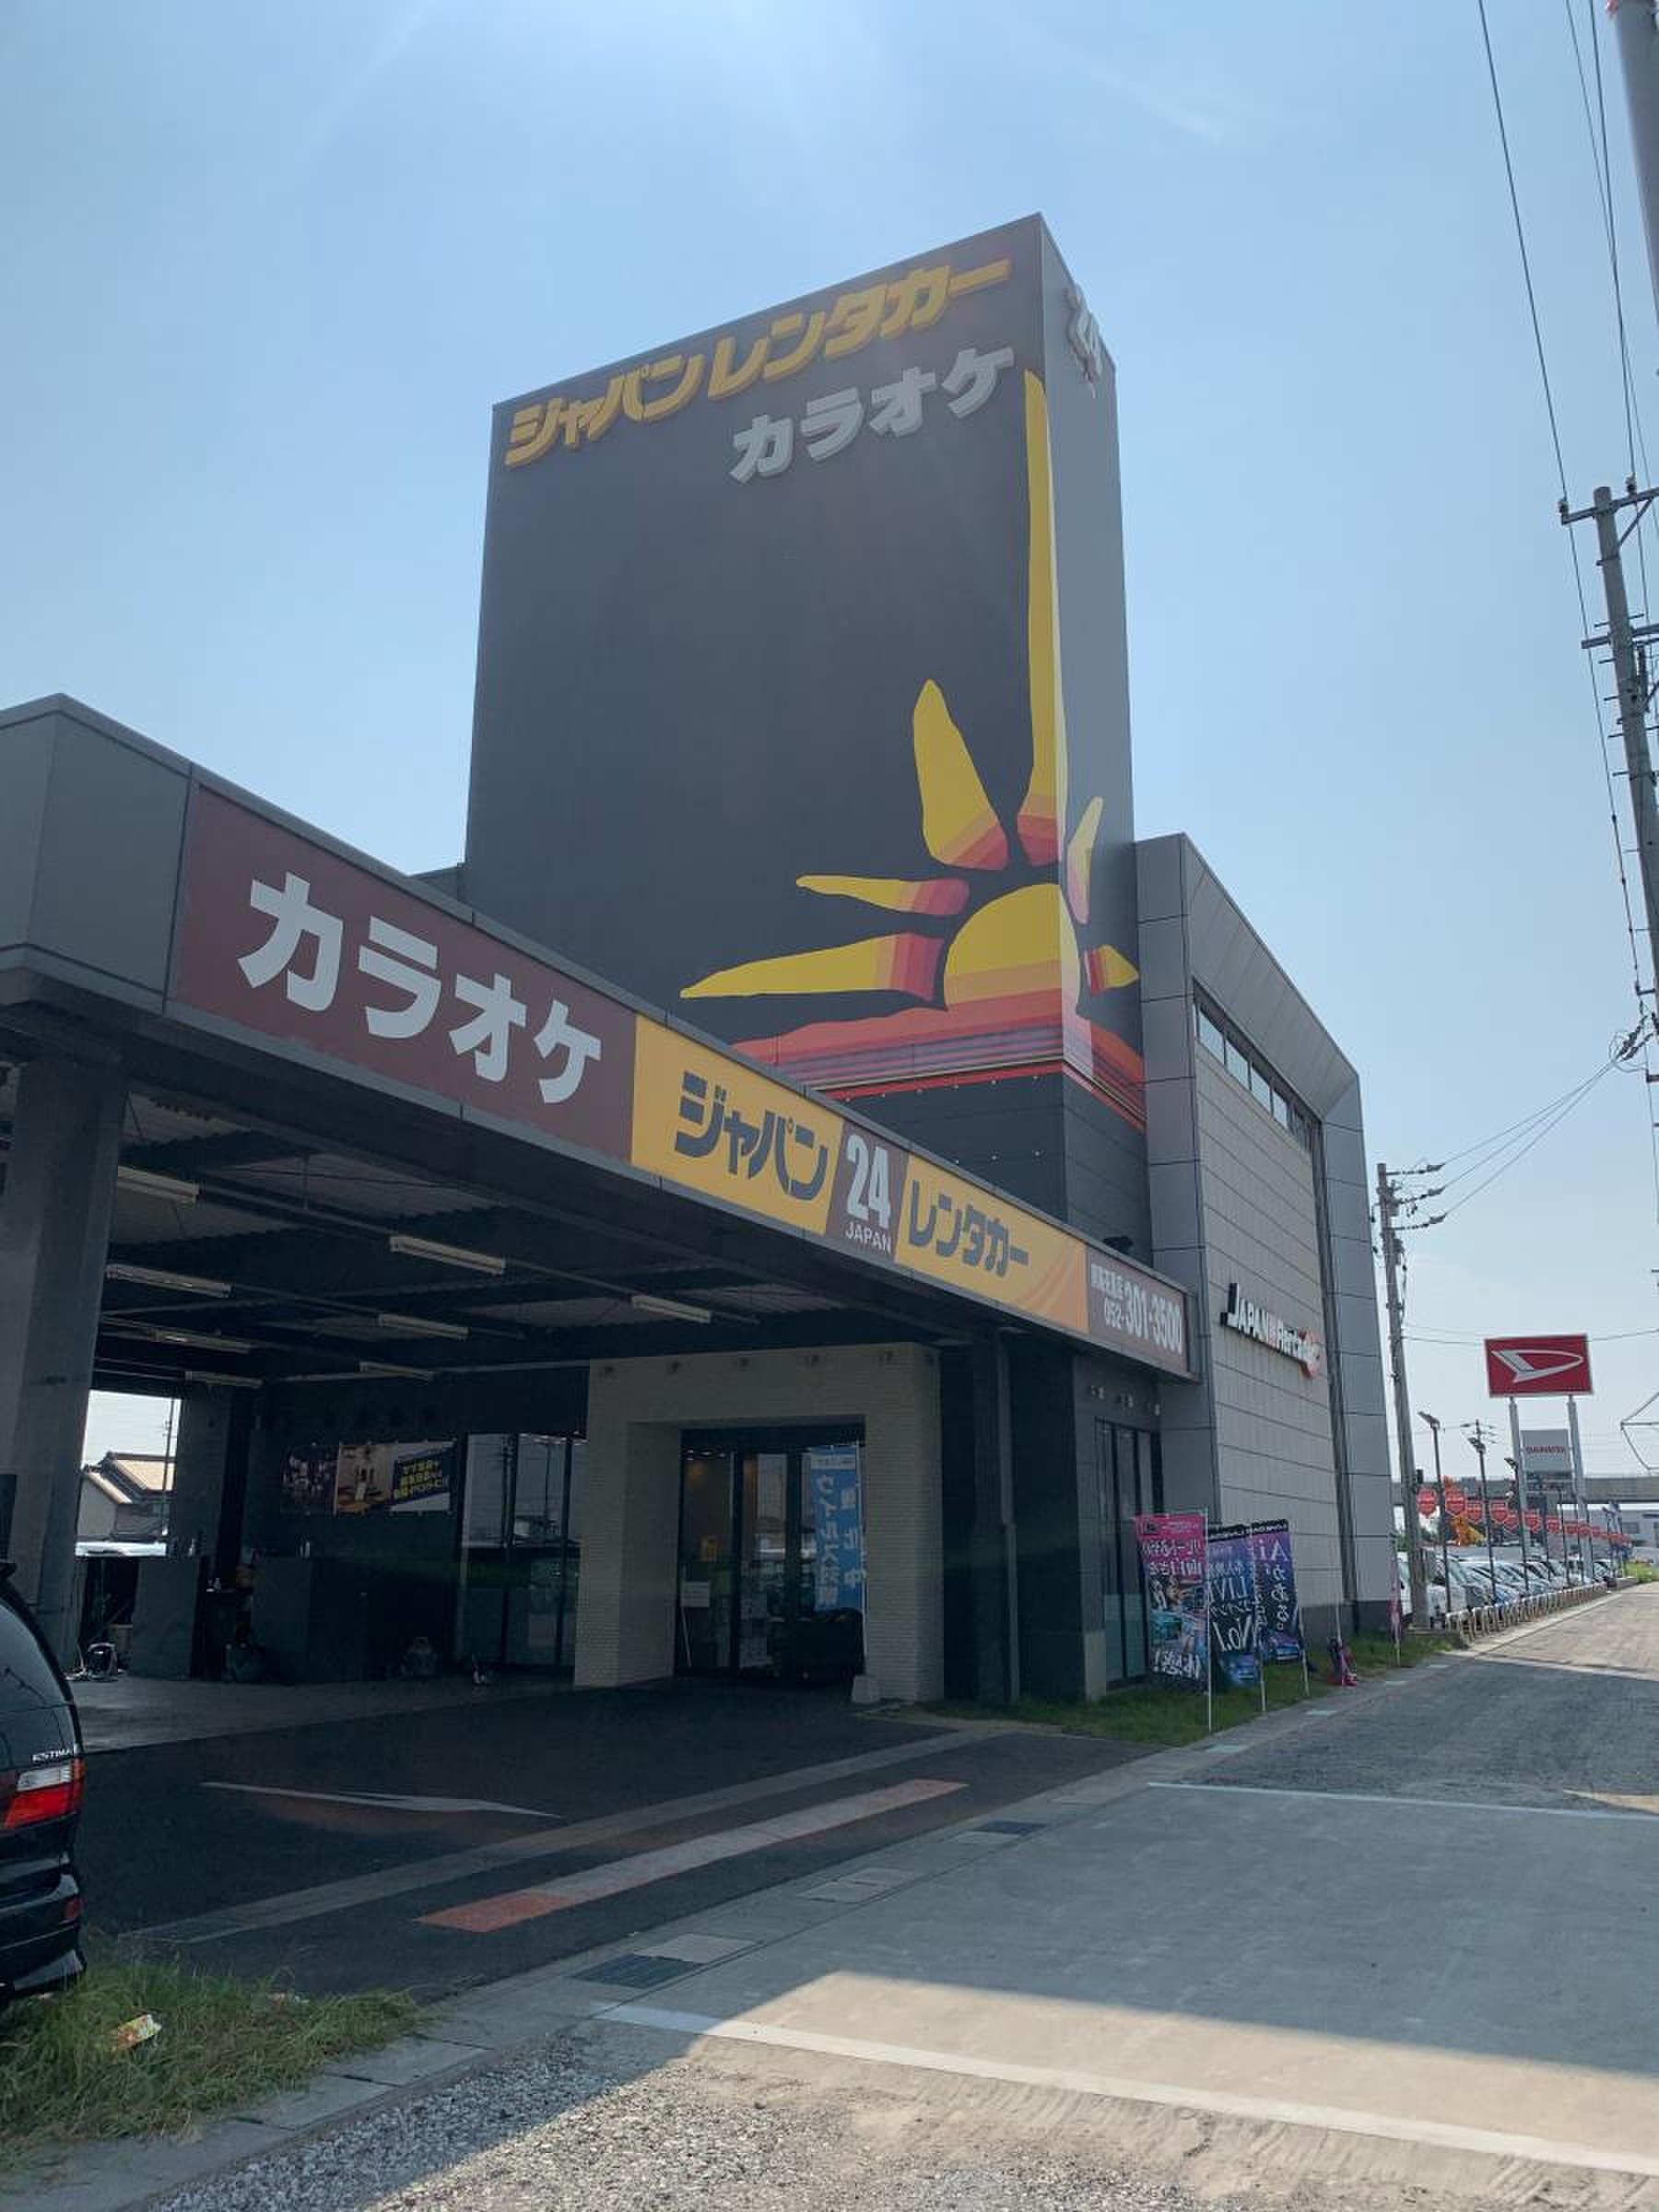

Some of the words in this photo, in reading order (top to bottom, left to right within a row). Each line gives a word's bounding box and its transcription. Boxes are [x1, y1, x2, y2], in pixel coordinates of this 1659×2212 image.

[729, 345, 1015, 486] カラオケ
[237, 871, 602, 1104] カラオケ
[674, 1070, 830, 1202] ジャパン
[844, 1134, 892, 1230] 24
[844, 1226, 893, 1253] JAPAN
[908, 1178, 1030, 1277] レンタカー
